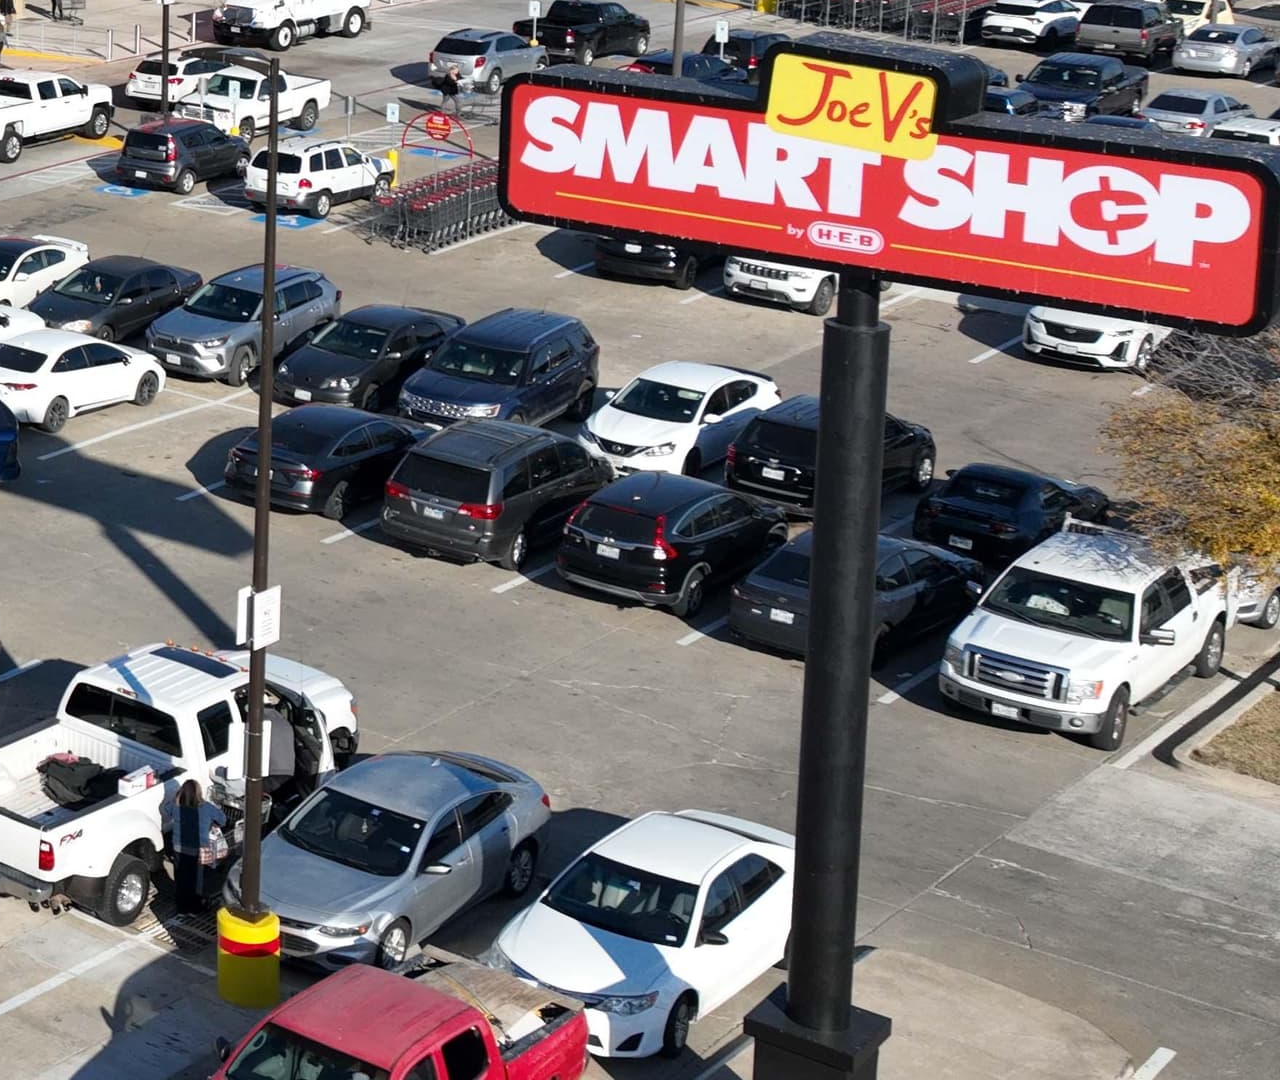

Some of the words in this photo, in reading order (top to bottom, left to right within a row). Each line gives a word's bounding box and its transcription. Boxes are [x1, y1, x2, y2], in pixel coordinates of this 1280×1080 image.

[520, 95, 883, 218] SMART
[899, 142, 1251, 267] SHOP
[786, 223, 805, 239] by
[59, 828, 83, 847] FX4
